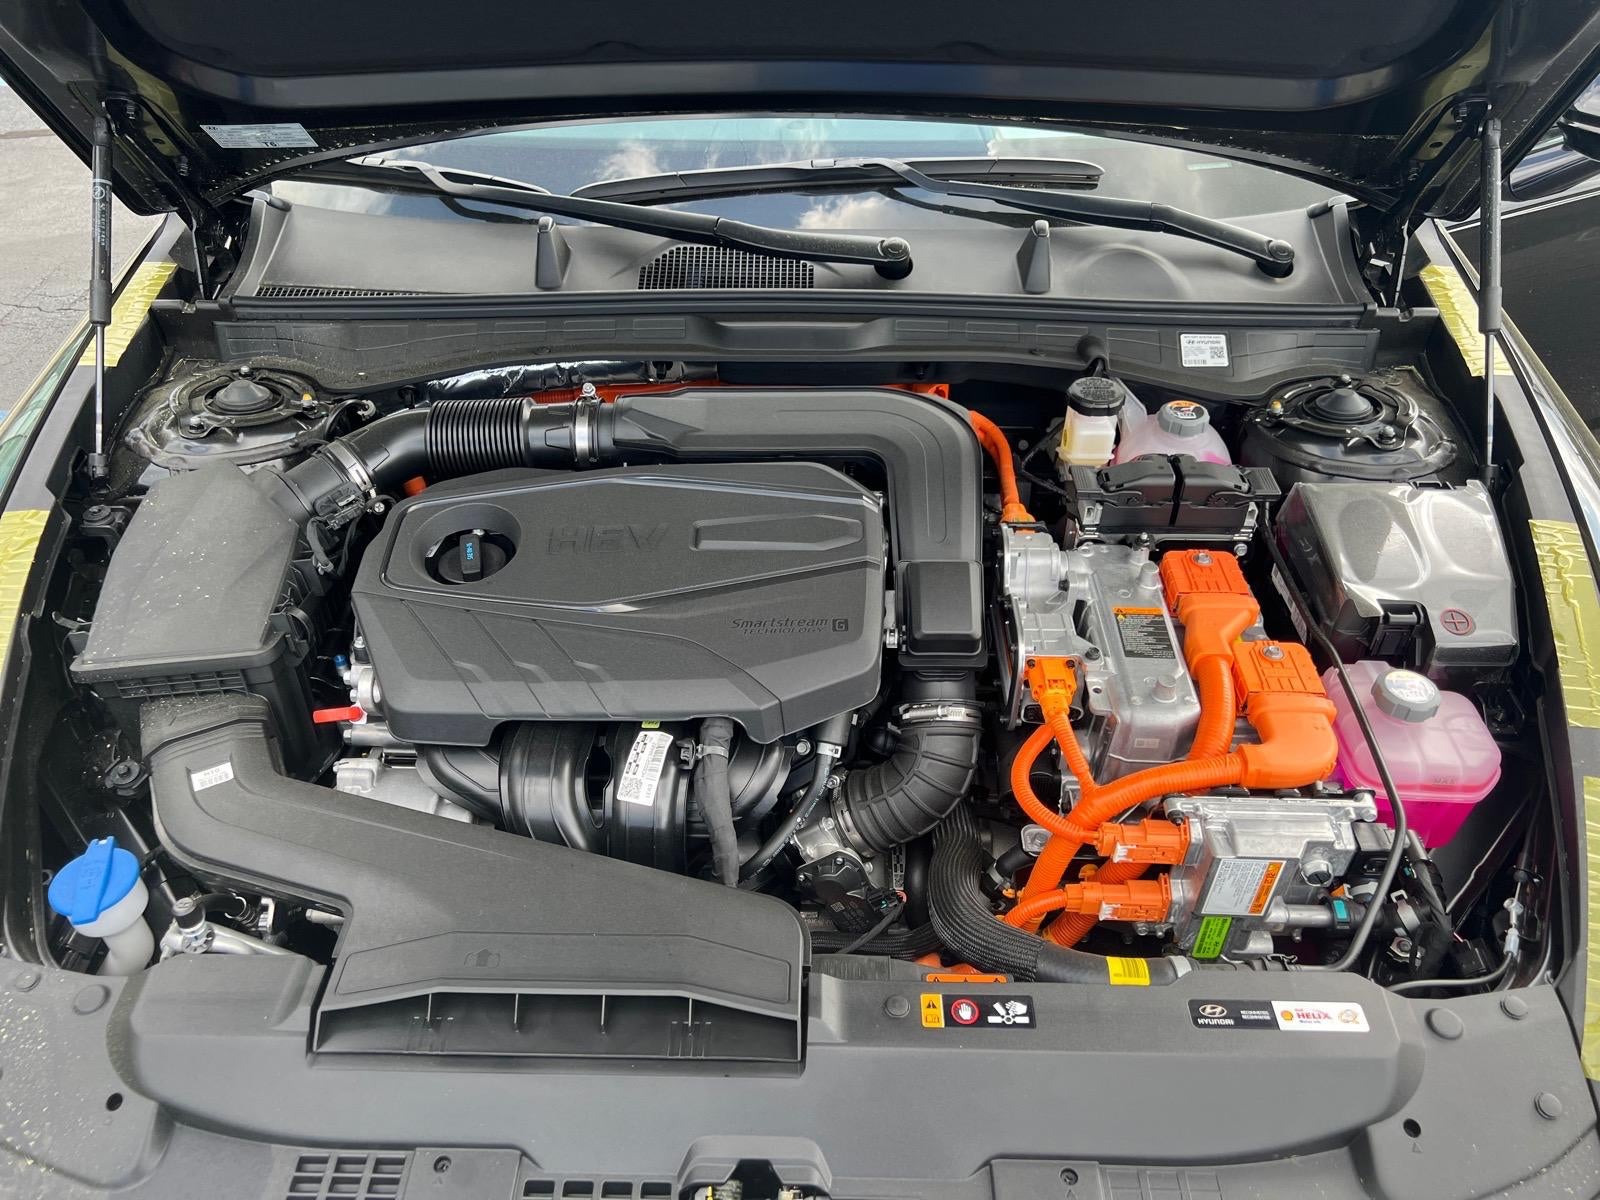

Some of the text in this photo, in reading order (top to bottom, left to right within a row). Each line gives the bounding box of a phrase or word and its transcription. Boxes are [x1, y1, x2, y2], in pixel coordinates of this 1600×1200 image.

[545, 526, 669, 554] HEV
[729, 618, 828, 629] Smartstream
[743, 627, 824, 636] TECHNOLOGY
[1296, 1012, 1330, 1020] HELIX
[1197, 1018, 1235, 1026] HYUNDAI
